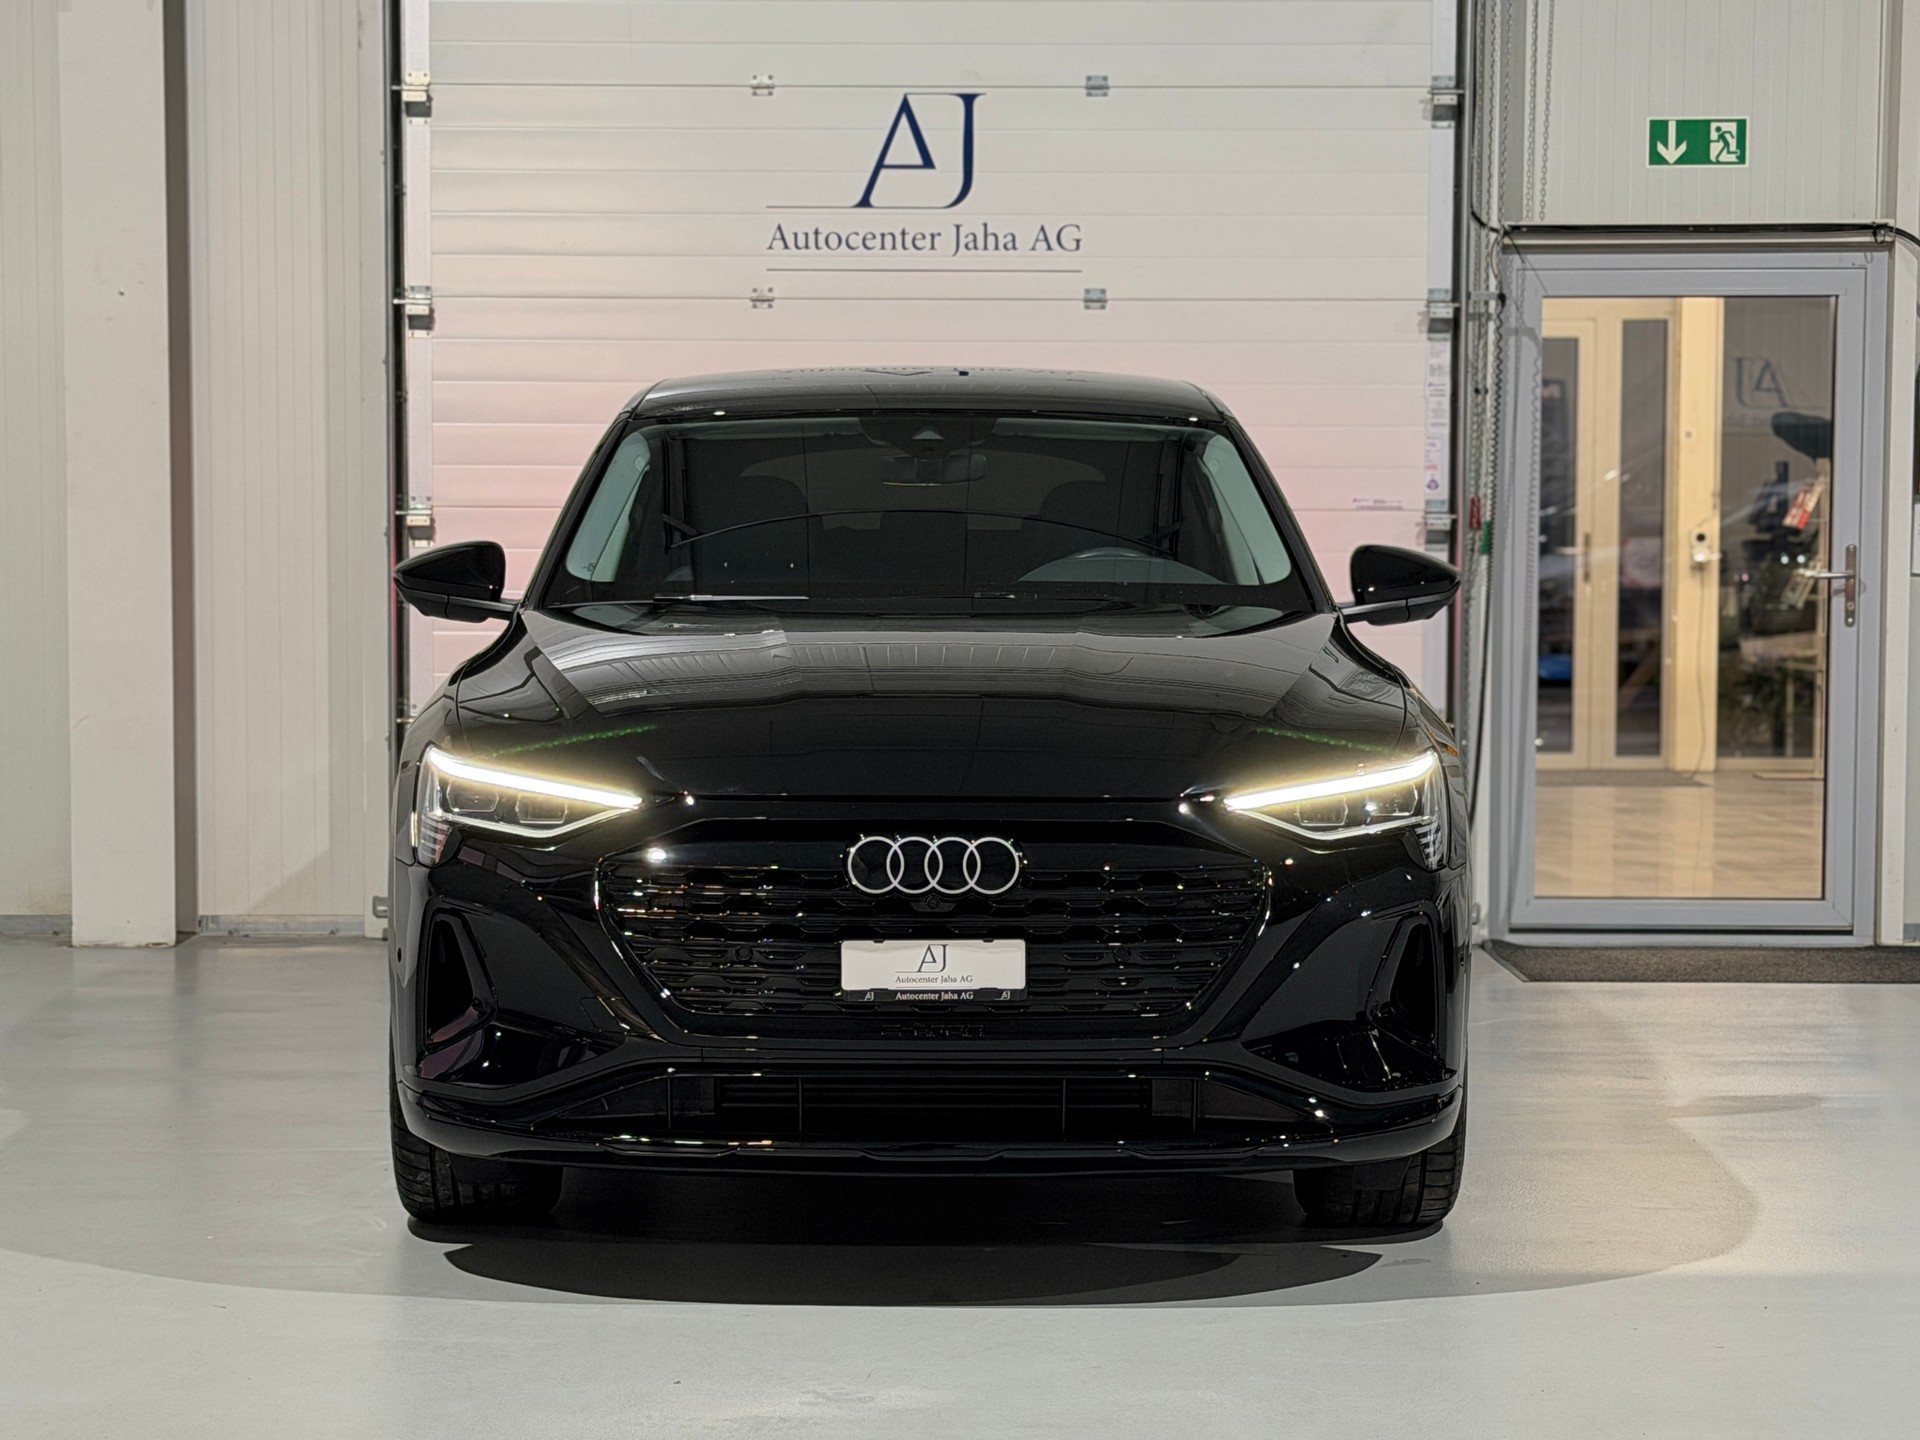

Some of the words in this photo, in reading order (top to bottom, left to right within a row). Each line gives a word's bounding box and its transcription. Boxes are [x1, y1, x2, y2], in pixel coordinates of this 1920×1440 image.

[850, 92, 986, 209] AJ
[766, 222, 941, 252] Autocenter
[952, 221, 1018, 257] Jaha
[1029, 223, 1082, 252] AG
[917, 943, 949, 973] AJ
[895, 975, 938, 984] Autocenter
[940, 974, 957, 984] Jaha
[959, 974, 973, 983] AG
[864, 991, 875, 1002] AJ
[895, 991, 939, 1001] Autocenter
[941, 991, 958, 1002] Jaha
[960, 991, 974, 1000] AG
[1000, 990, 1011, 1001] AJ
